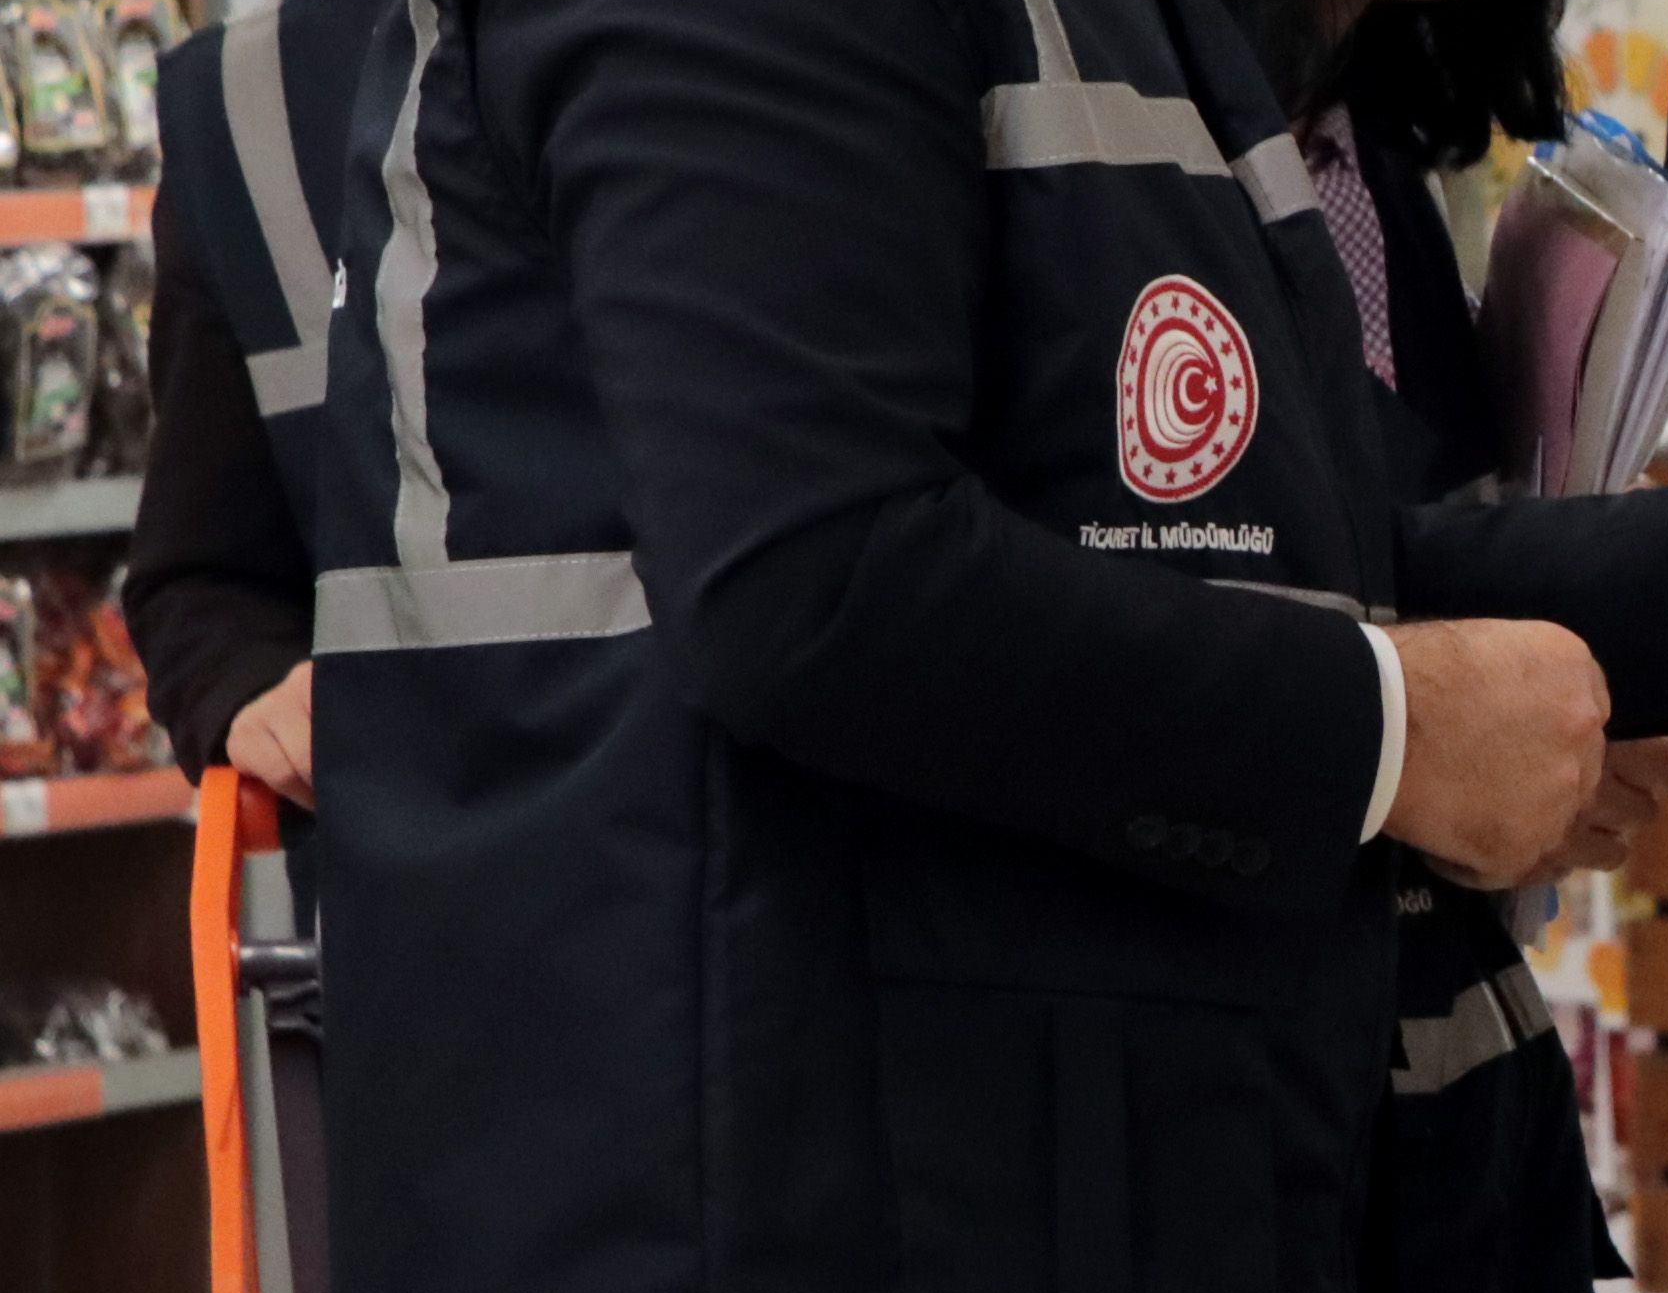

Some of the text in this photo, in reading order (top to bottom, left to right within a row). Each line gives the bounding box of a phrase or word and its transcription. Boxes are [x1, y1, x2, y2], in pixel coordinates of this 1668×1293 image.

[1080, 521, 1274, 555] TİCARET İL MÜDÜRLÜĞÜ
